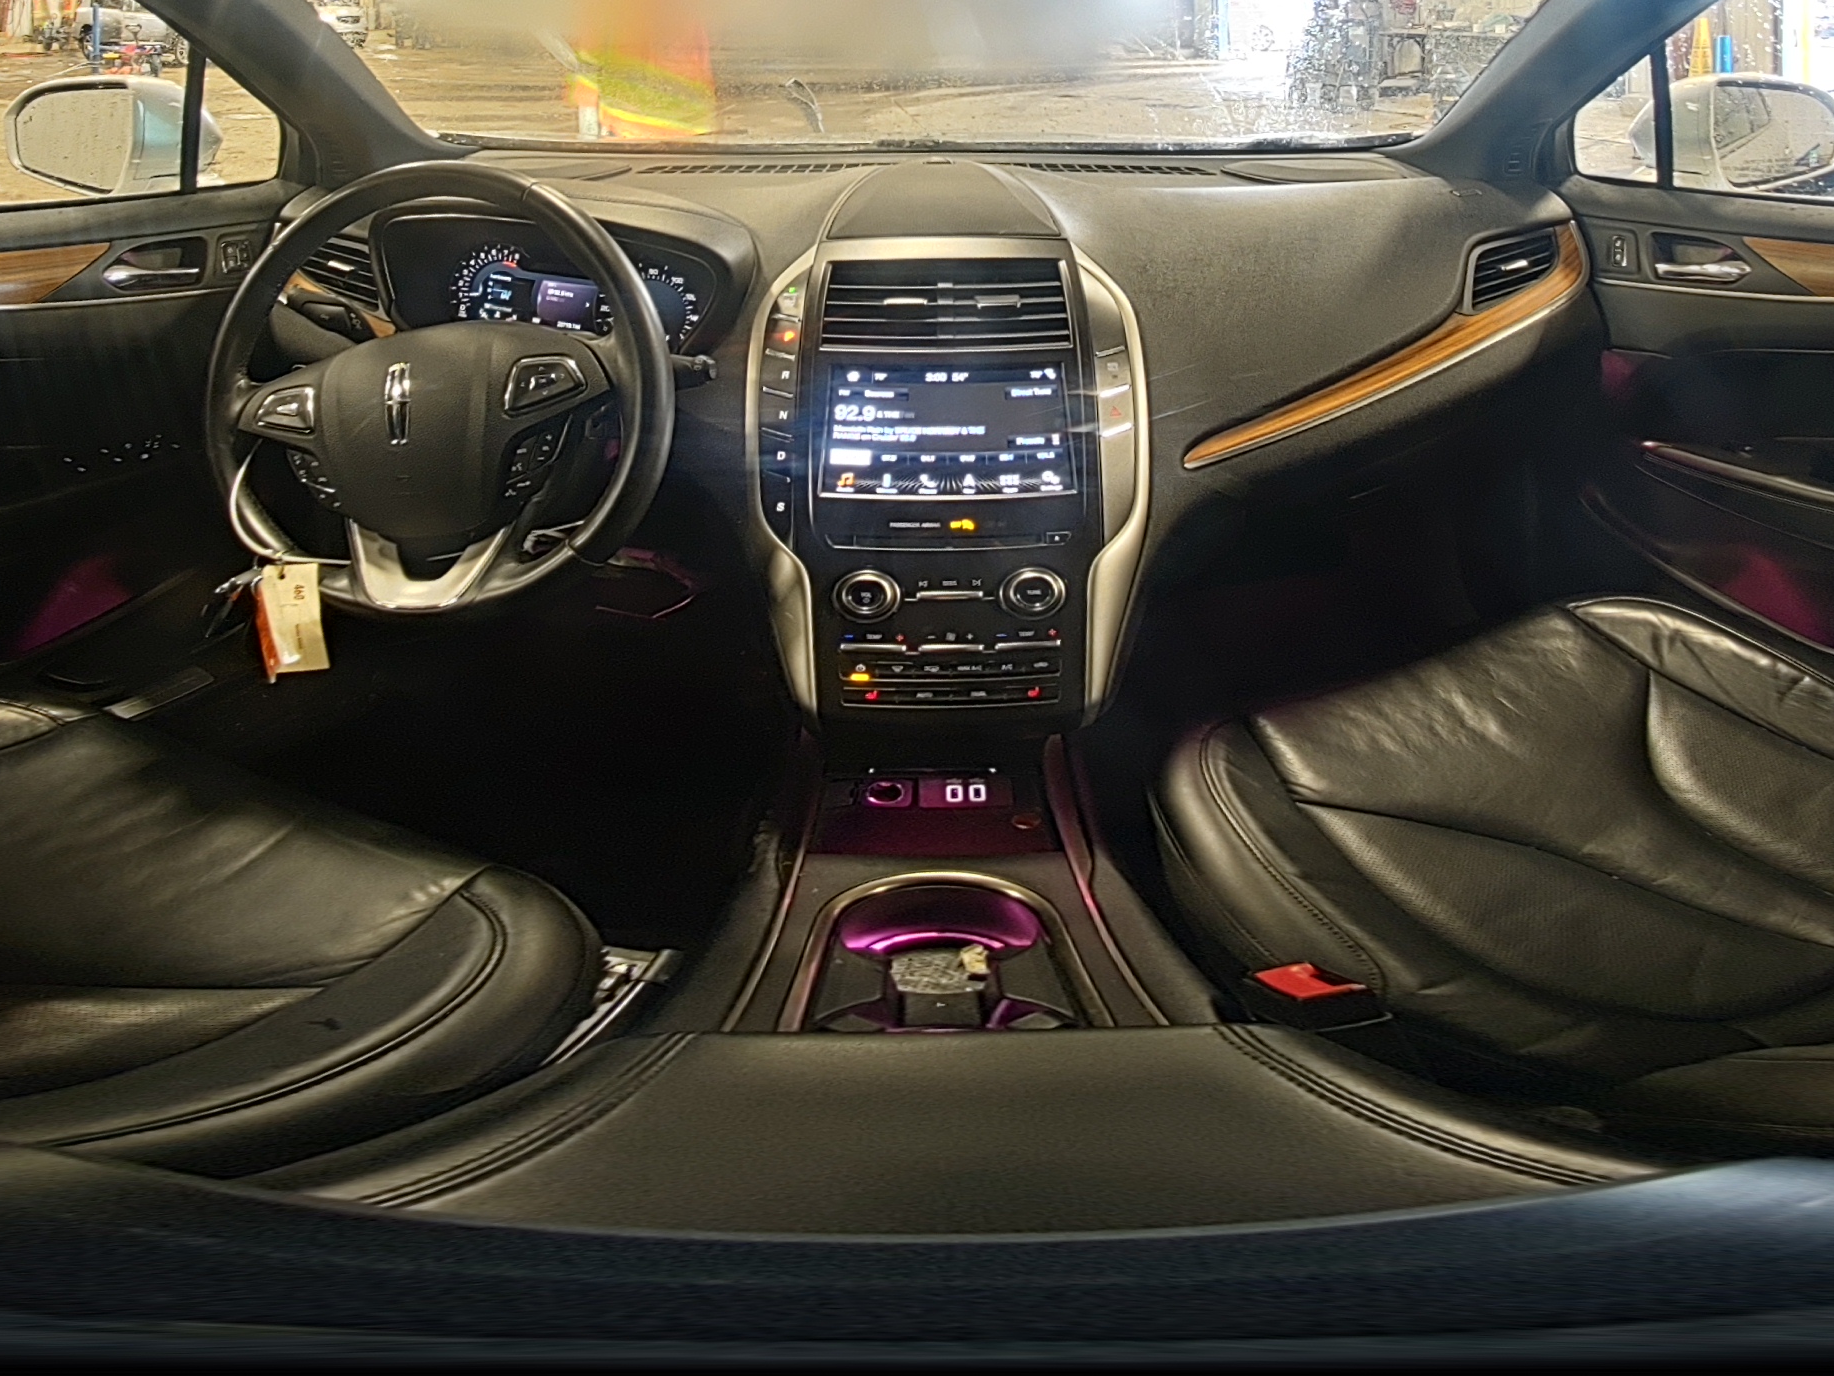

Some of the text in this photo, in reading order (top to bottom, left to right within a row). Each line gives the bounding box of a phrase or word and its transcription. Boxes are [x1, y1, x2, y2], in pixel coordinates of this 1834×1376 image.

[781, 371, 790, 379] R
[779, 411, 788, 419] N
[834, 404, 876, 422] 92.9
[777, 451, 786, 460] D
[776, 502, 785, 511] S
